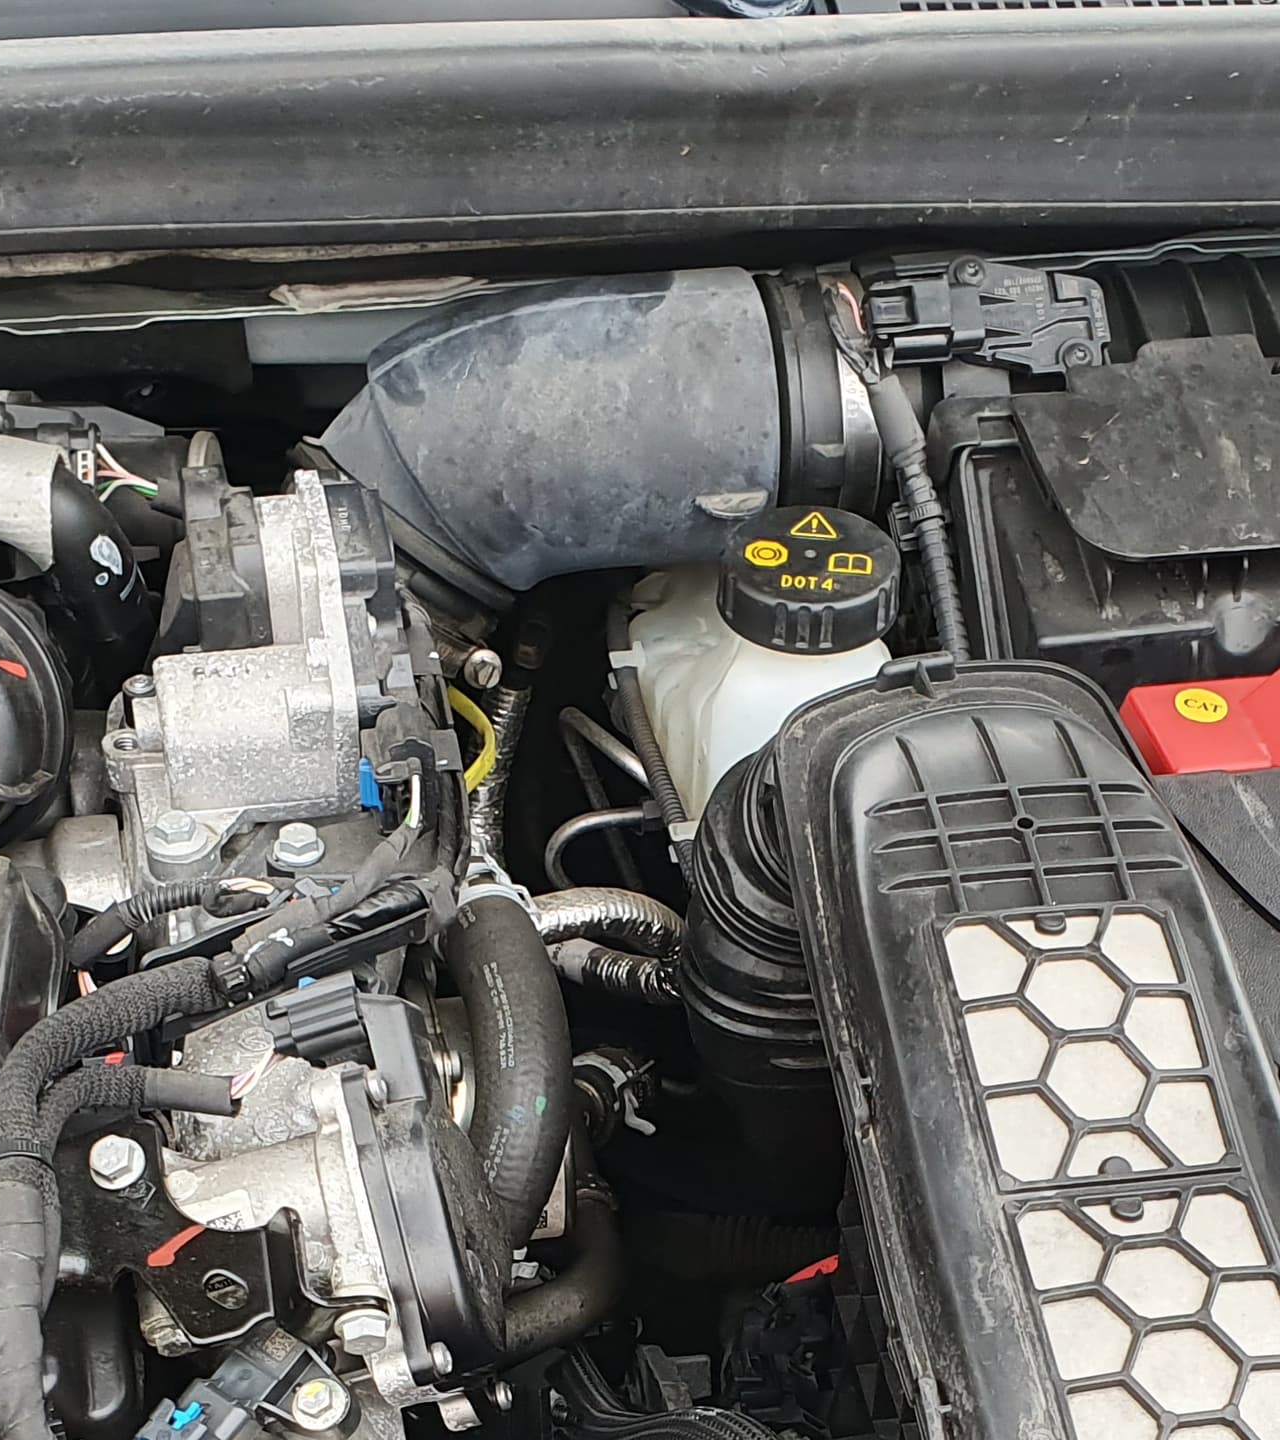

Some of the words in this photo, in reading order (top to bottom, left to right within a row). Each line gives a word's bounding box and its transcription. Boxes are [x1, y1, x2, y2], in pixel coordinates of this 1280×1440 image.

[780, 574, 819, 590] DOT
[821, 577, 834, 592] 4
[1183, 698, 1223, 713] CAT
